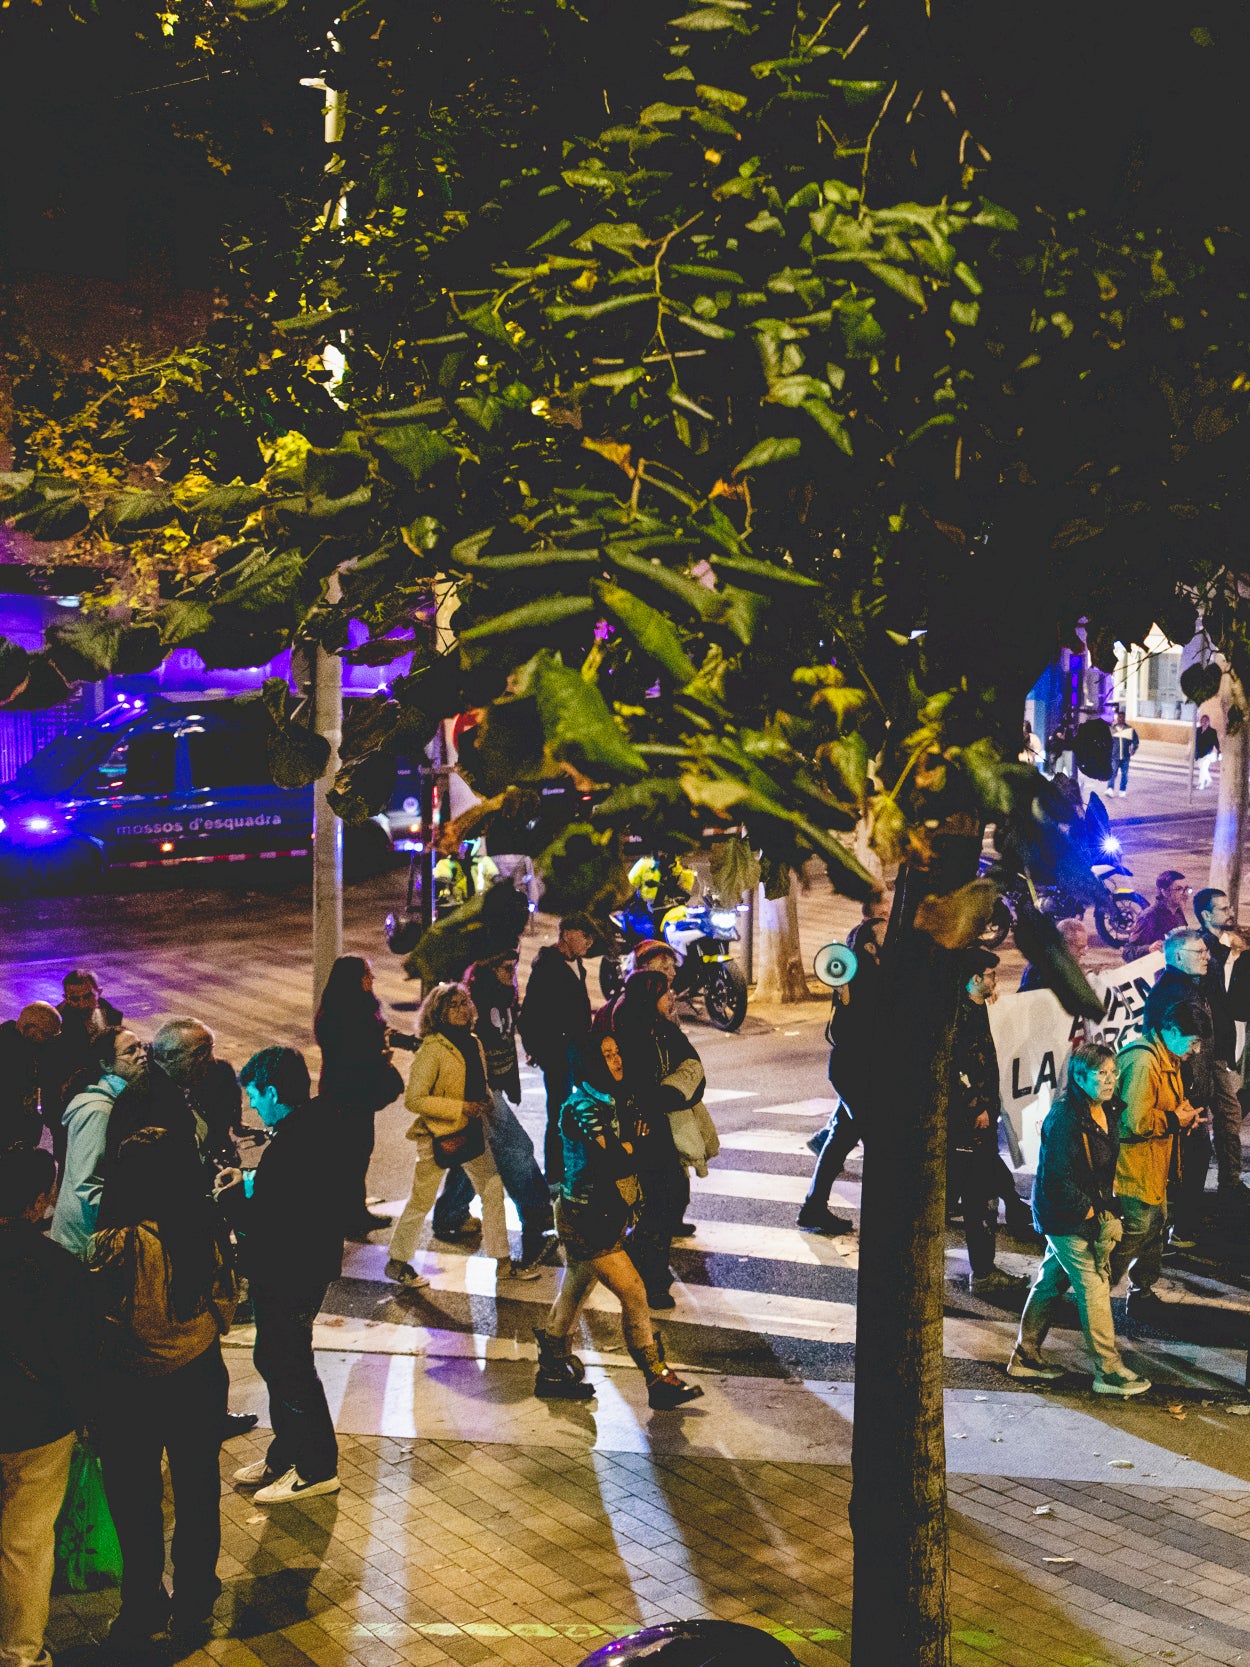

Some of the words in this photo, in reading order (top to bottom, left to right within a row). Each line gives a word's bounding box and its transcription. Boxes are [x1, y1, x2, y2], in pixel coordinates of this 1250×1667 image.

[116, 821, 183, 836] mossos
[189, 813, 282, 832] d'esquadra
[1012, 1050, 1058, 1100] LA
